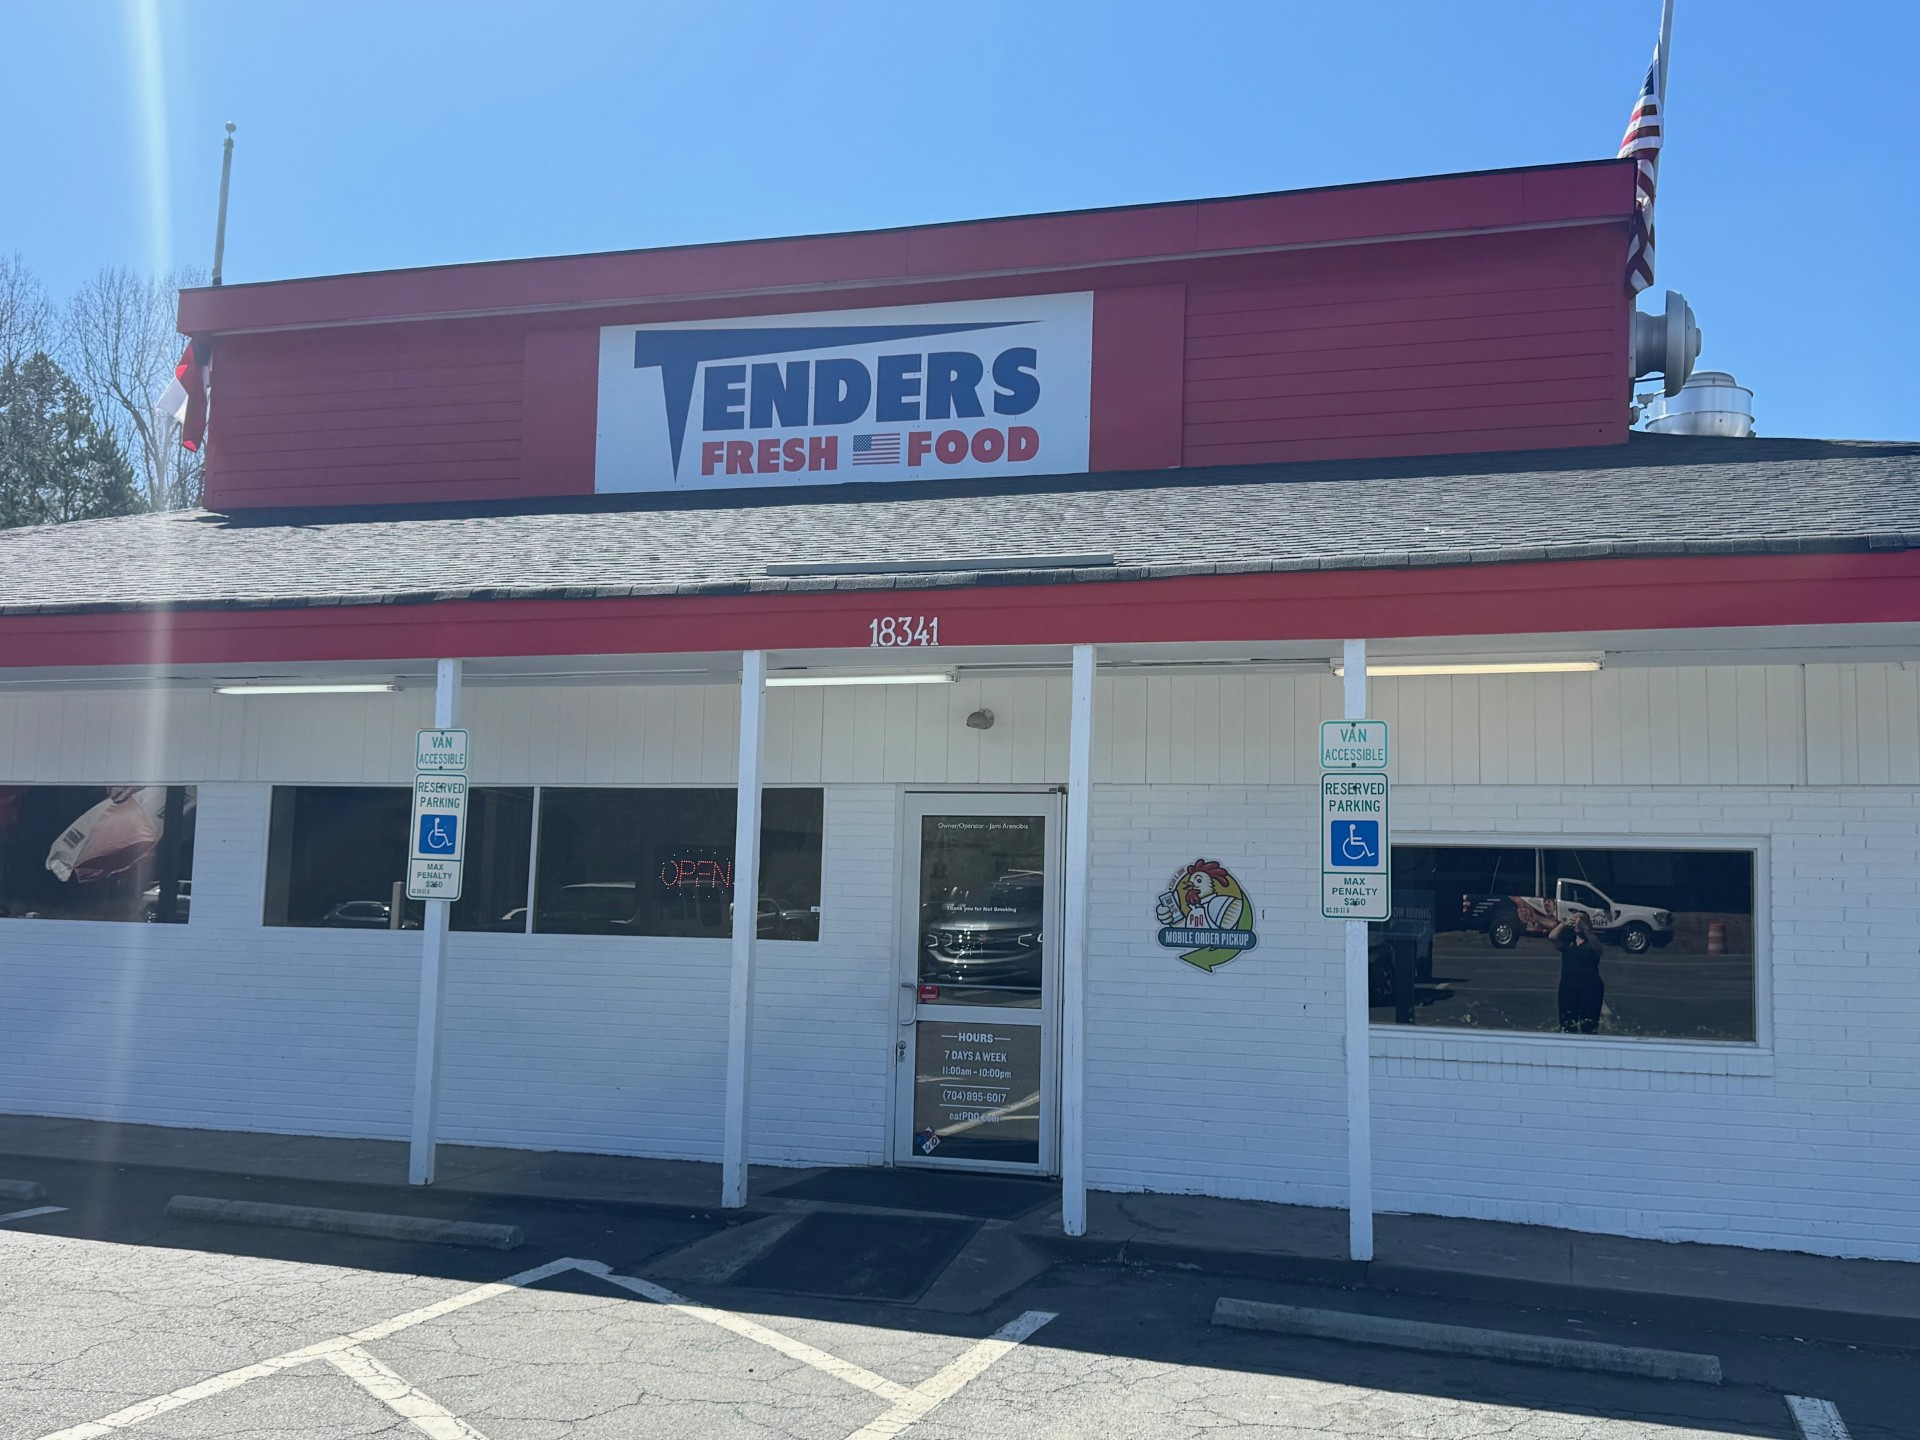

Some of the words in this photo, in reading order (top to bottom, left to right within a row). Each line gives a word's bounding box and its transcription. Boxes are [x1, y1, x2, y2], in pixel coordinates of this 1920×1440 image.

[634, 321, 1046, 483] TENDERS
[701, 436, 838, 476] FRESH
[907, 426, 1040, 467] FOOD
[869, 616, 939, 648] 18341
[1340, 728, 1367, 742] VAN
[431, 736, 452, 749] VAN
[418, 753, 464, 765] ACCESSIBLE
[1325, 748, 1384, 761] ACCESSIBLE
[418, 781, 464, 794] RESERVED
[1325, 782, 1385, 796] RESERVED
[420, 796, 460, 809] PARKING
[1329, 799, 1381, 812] PARKING
[427, 863, 444, 871] MAX
[417, 871, 453, 880] PENALTY
[661, 860, 731, 888] OPEN
[1343, 877, 1366, 886] MAX
[1332, 887, 1378, 897] PENALTY
[1344, 898, 1366, 906] $250
[1189, 914, 1204, 928] PDQ
[1165, 930, 1193, 944] MOBILE
[1195, 932, 1220, 945] ORDER
[1221, 934, 1249, 946] PICKUP
[958, 1032, 994, 1044] HOURS
[945, 1050, 950, 1060] 7
[951, 1050, 974, 1061] DAYS
[975, 1052, 981, 1061] A
[983, 1052, 1007, 1062] WEEK
[942, 1066, 972, 1076] 11:00am
[979, 1068, 1012, 1080] 10:00pm
